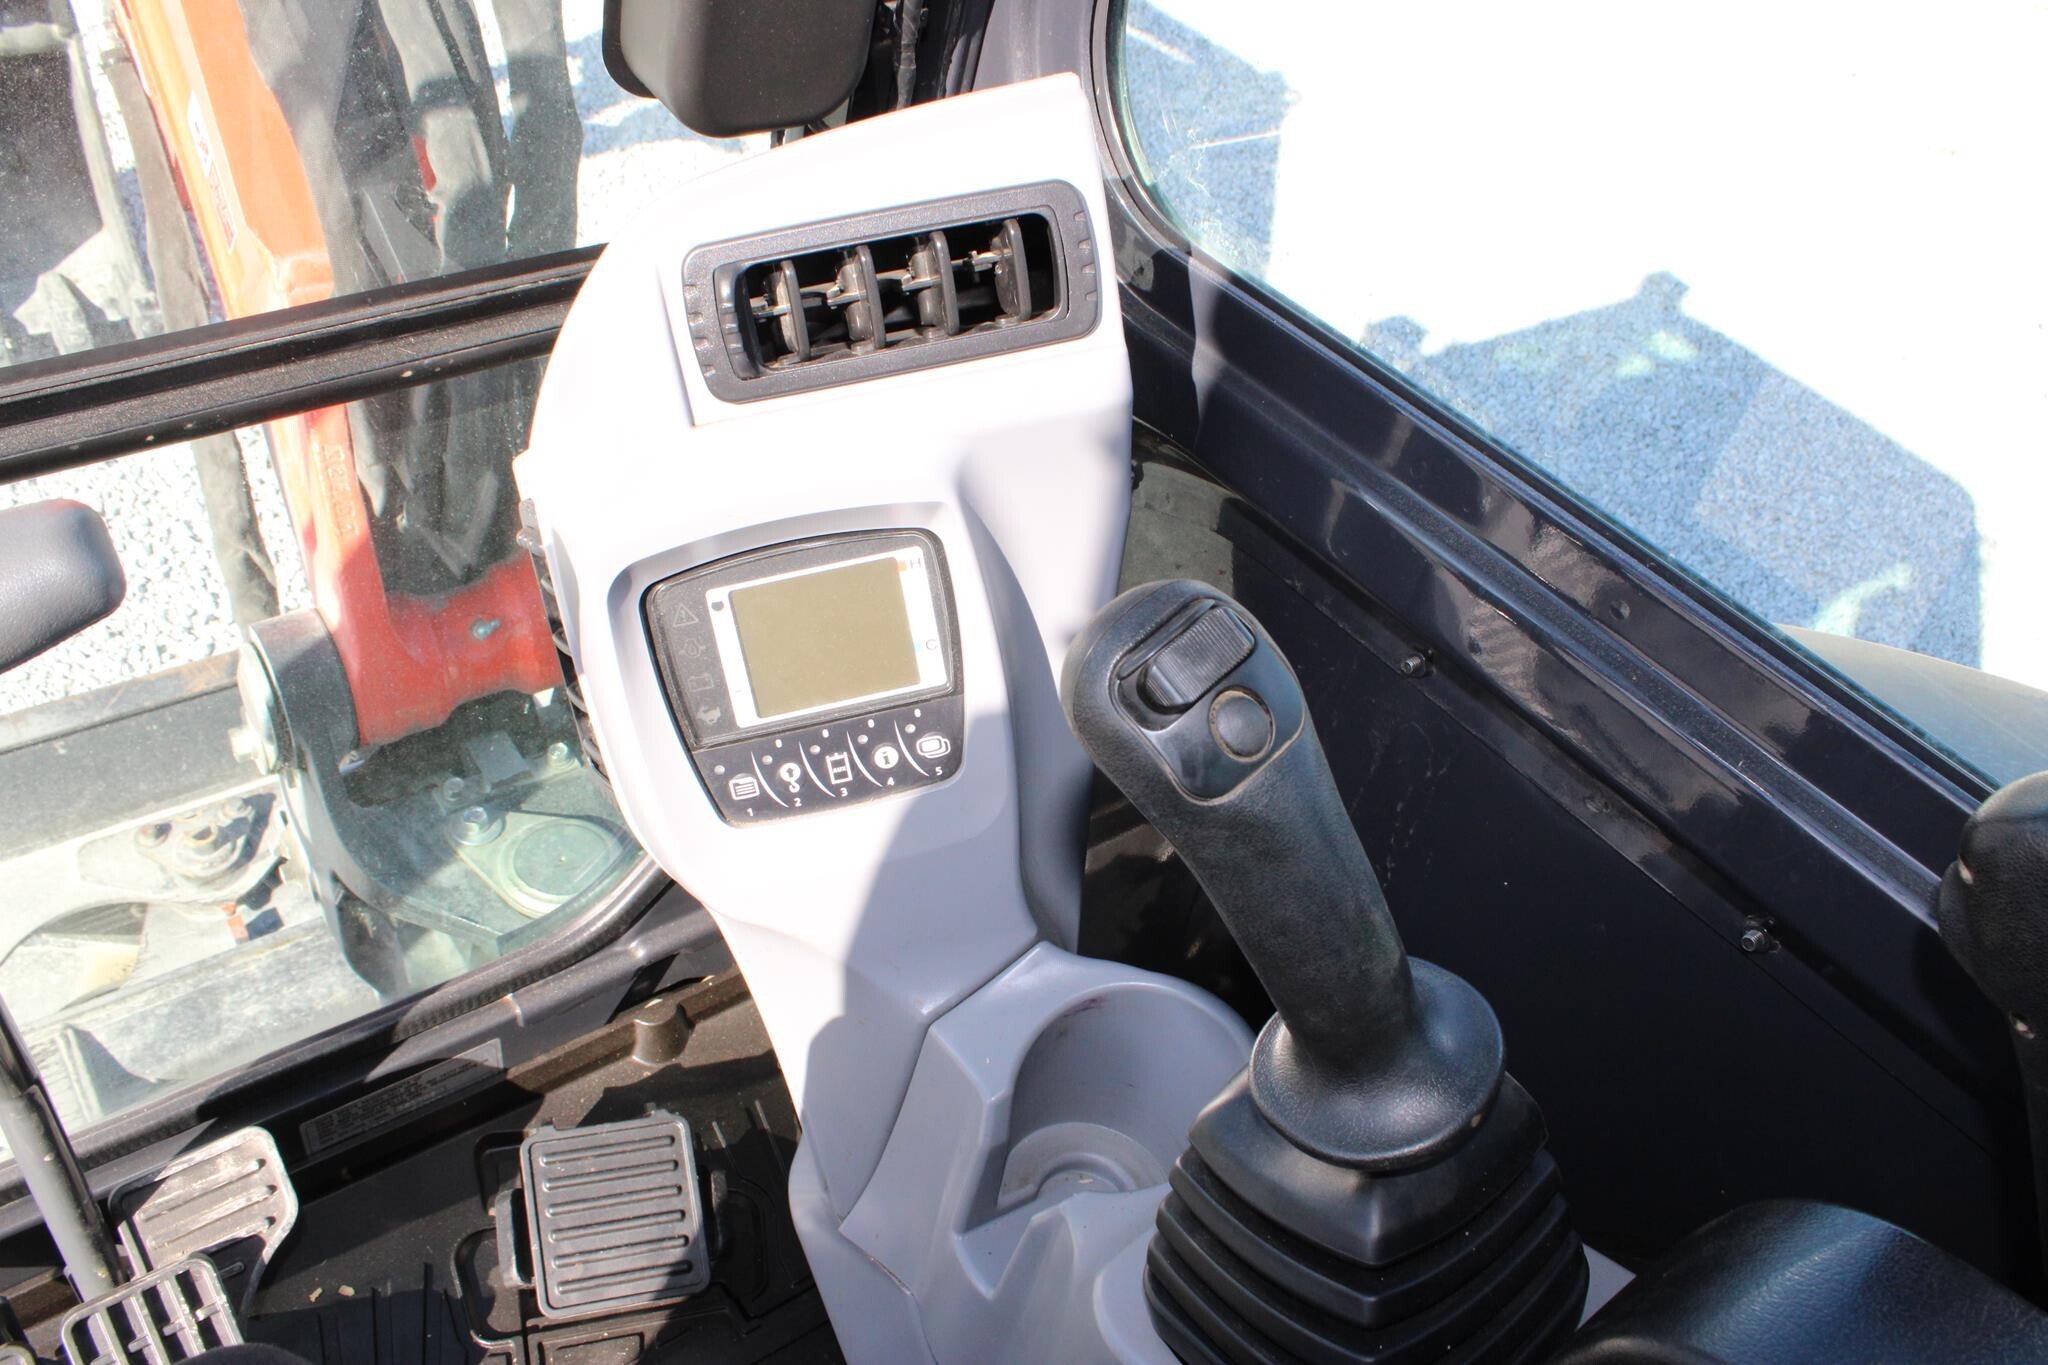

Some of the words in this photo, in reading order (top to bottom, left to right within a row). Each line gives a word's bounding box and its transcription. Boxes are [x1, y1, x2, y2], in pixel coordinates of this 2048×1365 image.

[910, 557, 922, 569] H
[925, 638, 938, 651] C
[935, 766, 943, 776] 5
[887, 777, 895, 786] 4
[840, 788, 848, 797] 3
[794, 798, 802, 808] 2
[746, 808, 754, 817] 1
